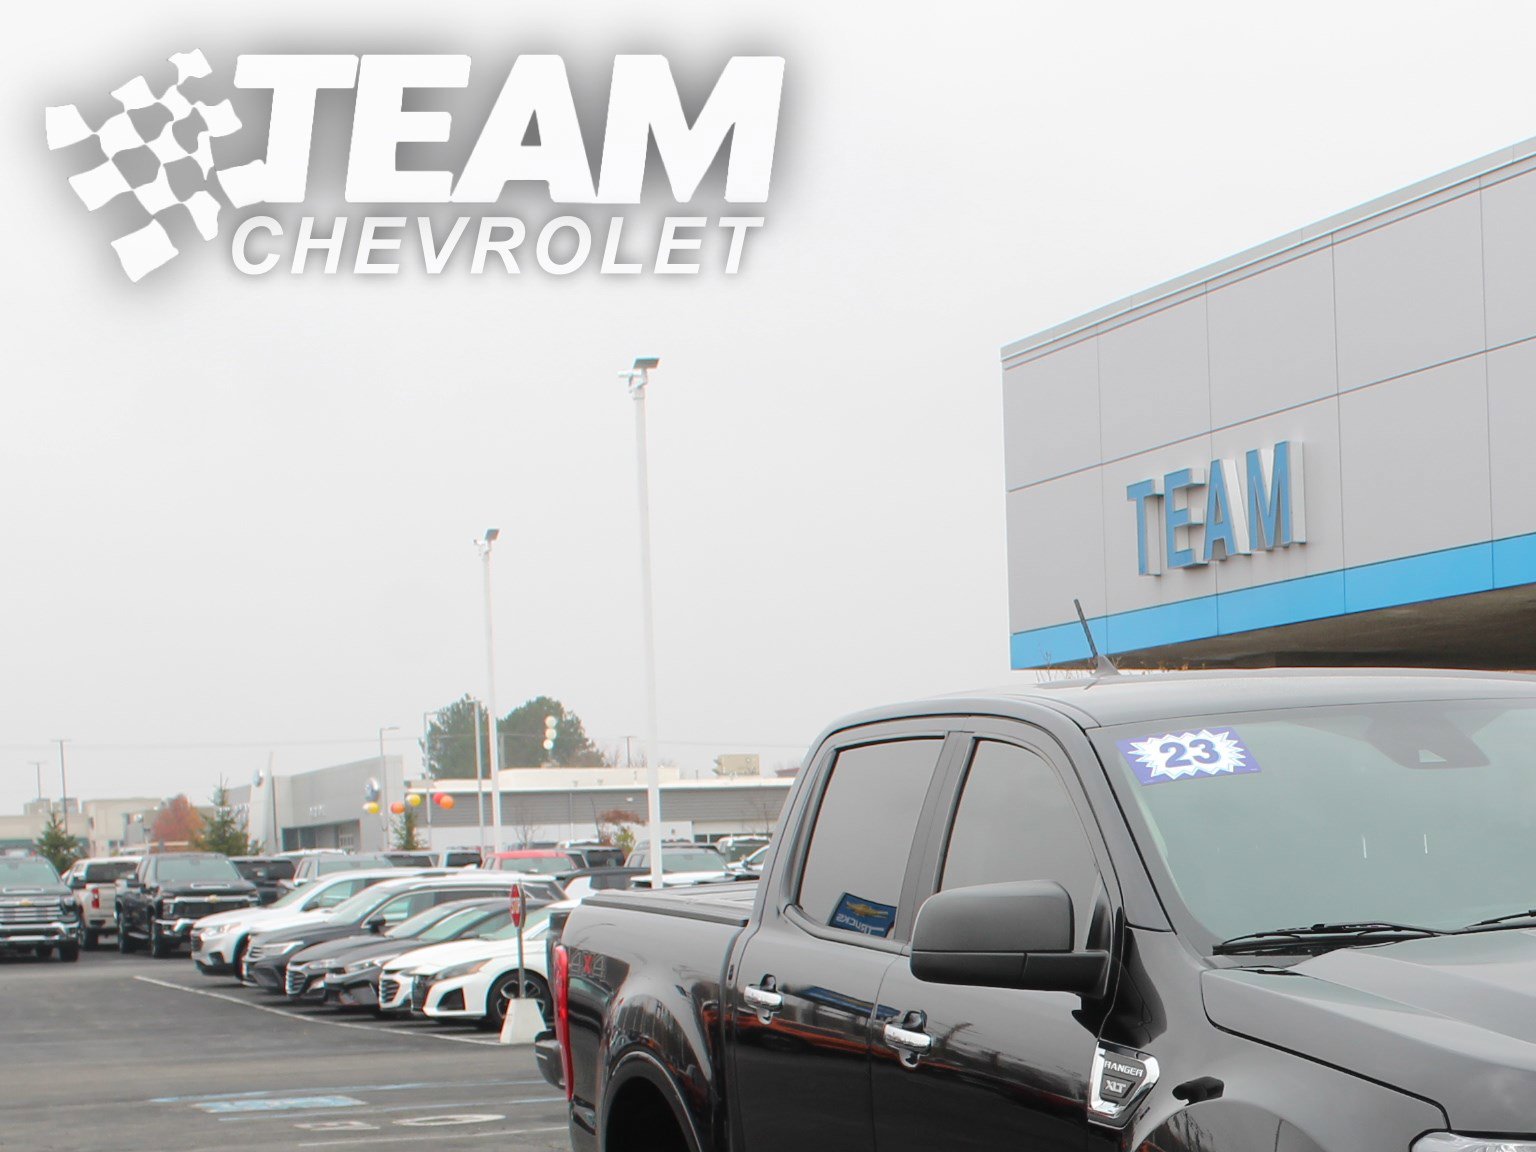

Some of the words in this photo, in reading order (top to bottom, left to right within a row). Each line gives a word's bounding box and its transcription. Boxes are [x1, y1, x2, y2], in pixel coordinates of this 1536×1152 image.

[1126, 440, 1306, 576] TEAM
[1158, 738, 1221, 769] 23
[1104, 1060, 1144, 1077] RANGER
[1104, 1080, 1127, 1094] XLT
